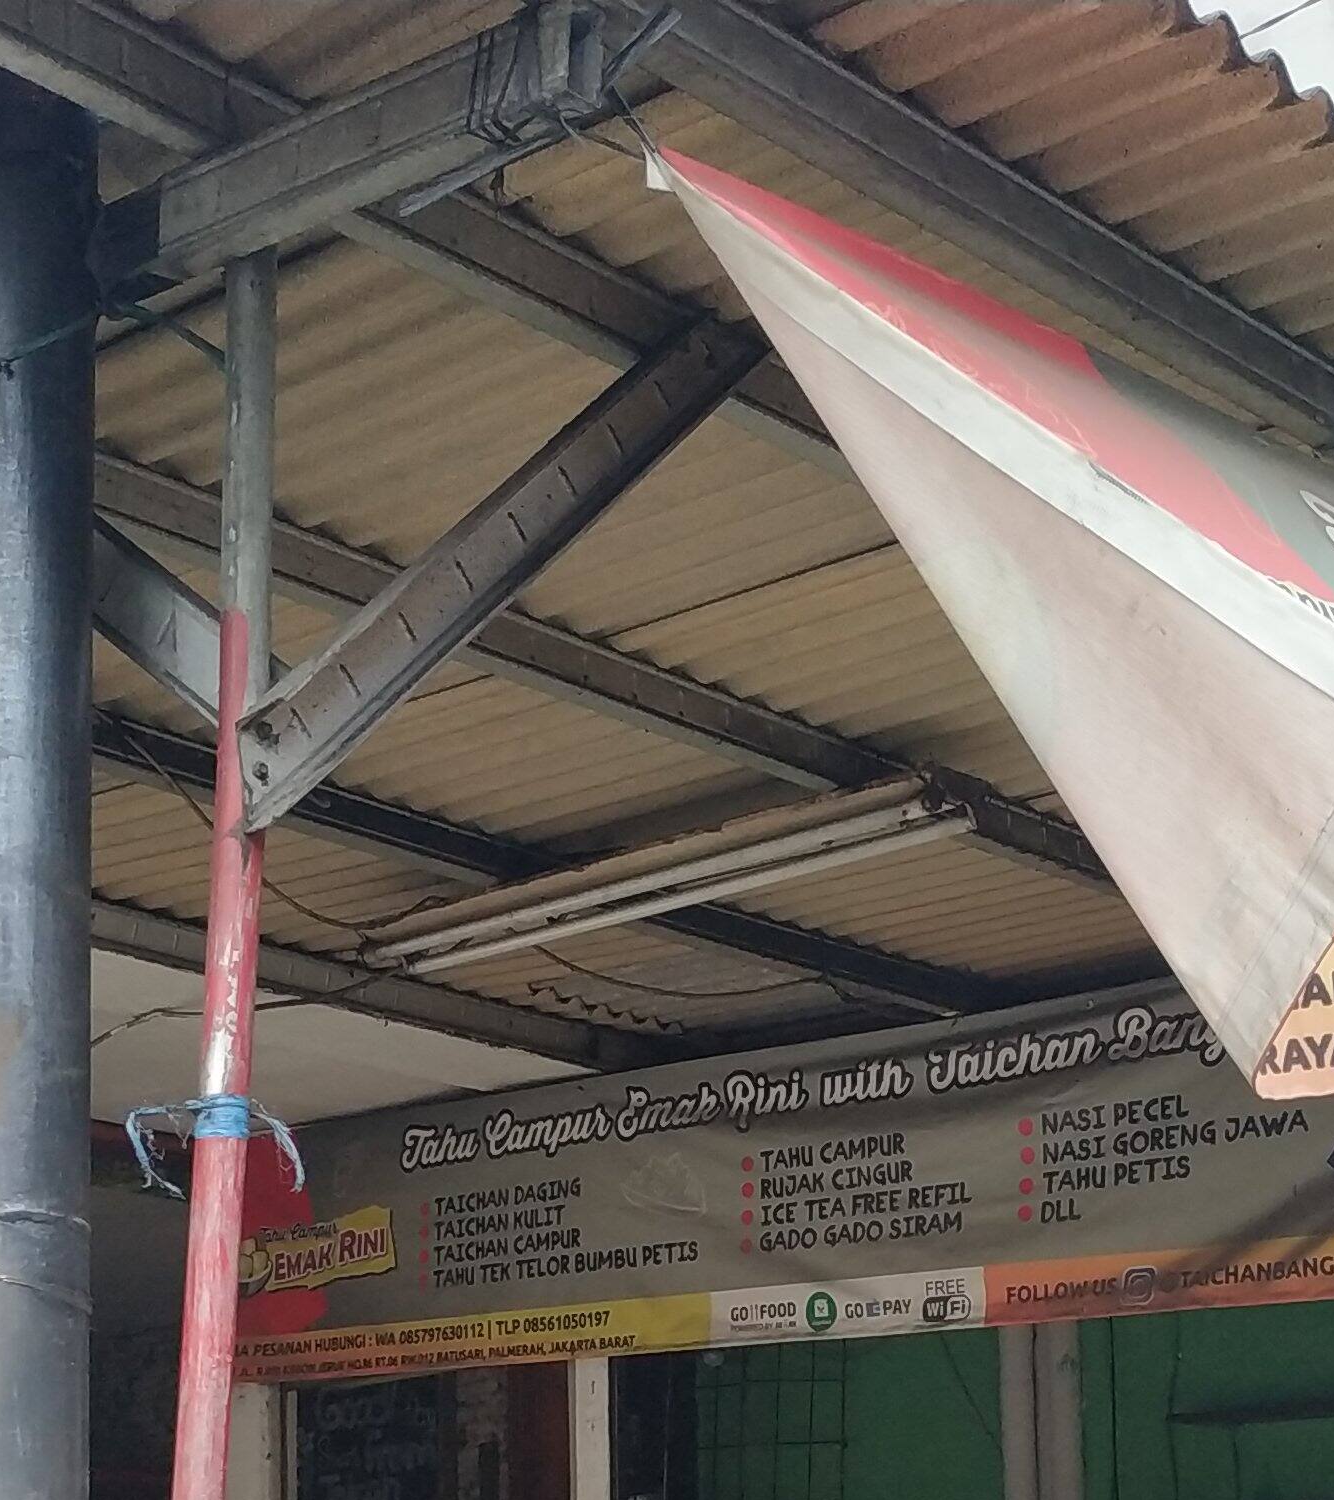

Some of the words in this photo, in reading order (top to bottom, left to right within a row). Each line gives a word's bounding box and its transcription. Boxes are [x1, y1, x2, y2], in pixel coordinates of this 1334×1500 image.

[401, 1126, 480, 1171] Tahu
[484, 1104, 612, 1157] Campur
[615, 1085, 722, 1139] Emak
[725, 1069, 810, 1132] Rini
[821, 1057, 915, 1107] with
[927, 1031, 1104, 1092] Taichan
[1041, 1104, 1107, 1136] NASI
[1113, 1094, 1190, 1128] PECEL
[759, 1145, 814, 1173] TAHU
[819, 1132, 906, 1165] CAMPUR
[1042, 1134, 1107, 1166] NASI
[1112, 1119, 1217, 1157] GORENG
[1224, 1108, 1310, 1143] JAWA
[759, 1171, 825, 1200] RUJAK
[831, 1159, 914, 1191] CINGUR
[1042, 1164, 1107, 1195] TAHU
[1113, 1155, 1192, 1187] PETIS
[434, 1188, 509, 1217] TAICHAN
[514, 1176, 582, 1205] DAGING
[760, 1200, 798, 1227] ICE
[803, 1196, 846, 1223] TEA
[851, 1188, 902, 1218] FREE
[907, 1181, 973, 1210] REFIL
[1039, 1198, 1082, 1224] DLL
[433, 1214, 509, 1241] TAICHAN
[513, 1204, 566, 1231] KULIT
[759, 1226, 818, 1253] GADO
[823, 1219, 884, 1248] GADO
[888, 1210, 964, 1241] SIRAM
[273, 1242, 335, 1282] EMAK
[337, 1227, 388, 1264] RINI
[432, 1264, 475, 1289] TAHU
[479, 1261, 511, 1285] TEK
[515, 1253, 571, 1281] TELOR
[574, 1246, 638, 1275] BUMBU
[642, 1240, 700, 1268] PETIS
[433, 1237, 509, 1267] TAICHAN
[513, 1227, 581, 1254] CAMPUR
[882, 1297, 913, 1316] PAY
[924, 1277, 966, 1297] FREE
[375, 1332, 396, 1348] WA
[398, 1321, 485, 1345] 085797630112
[495, 1319, 521, 1336] TLP
[522, 1309, 611, 1334] 08561050197
[598, 1334, 637, 1349] BARAT
